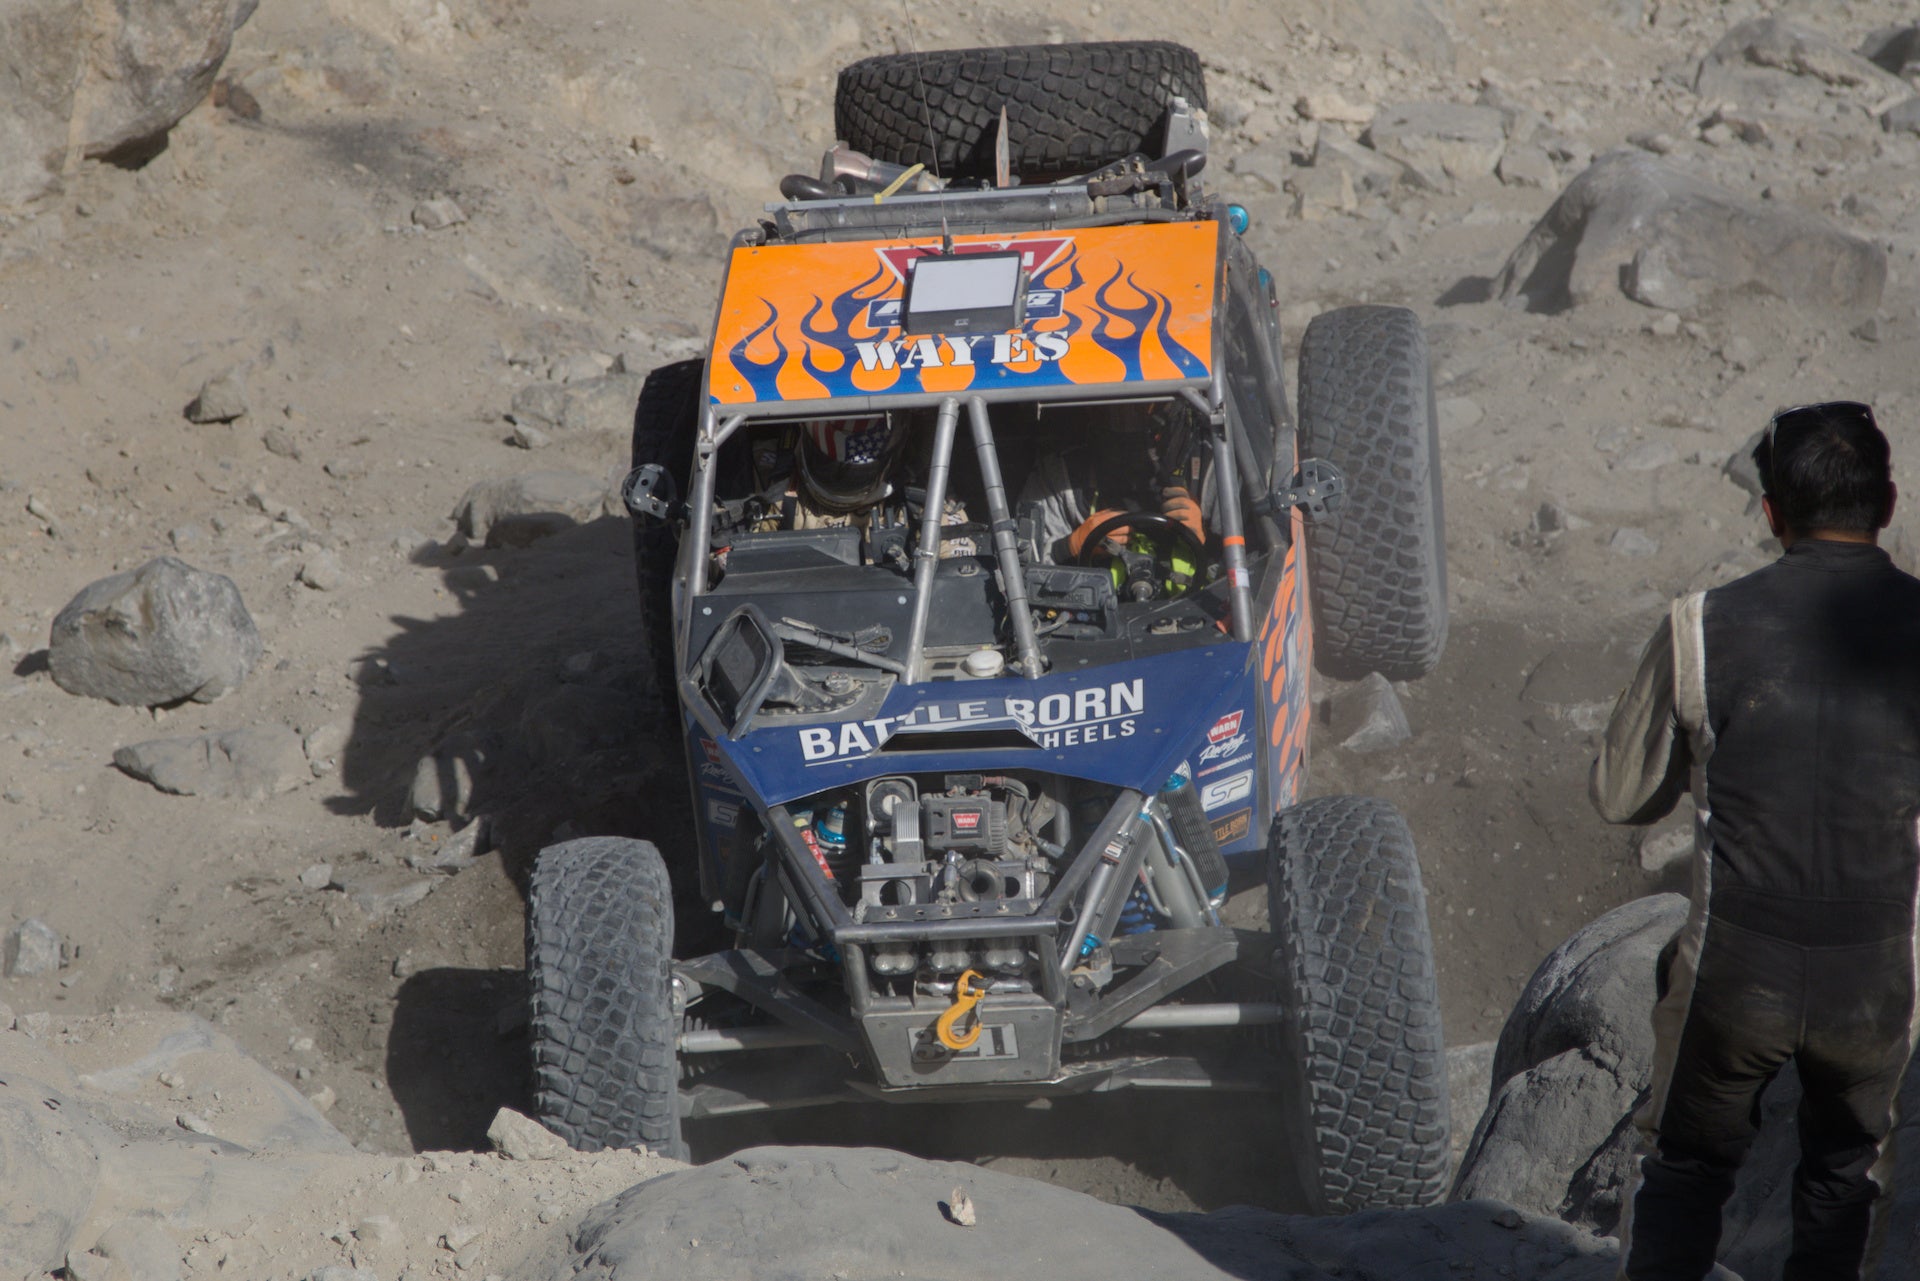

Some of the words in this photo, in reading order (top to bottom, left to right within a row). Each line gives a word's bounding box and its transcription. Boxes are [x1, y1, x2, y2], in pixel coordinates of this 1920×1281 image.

[854, 330, 1070, 371] WAYES
[799, 701, 989, 761] BATTLE
[1005, 679, 1144, 727] BORN
[1019, 719, 1136, 749] WHEELS
[1210, 719, 1238, 737] WARN
[1206, 775, 1249, 807] SP
